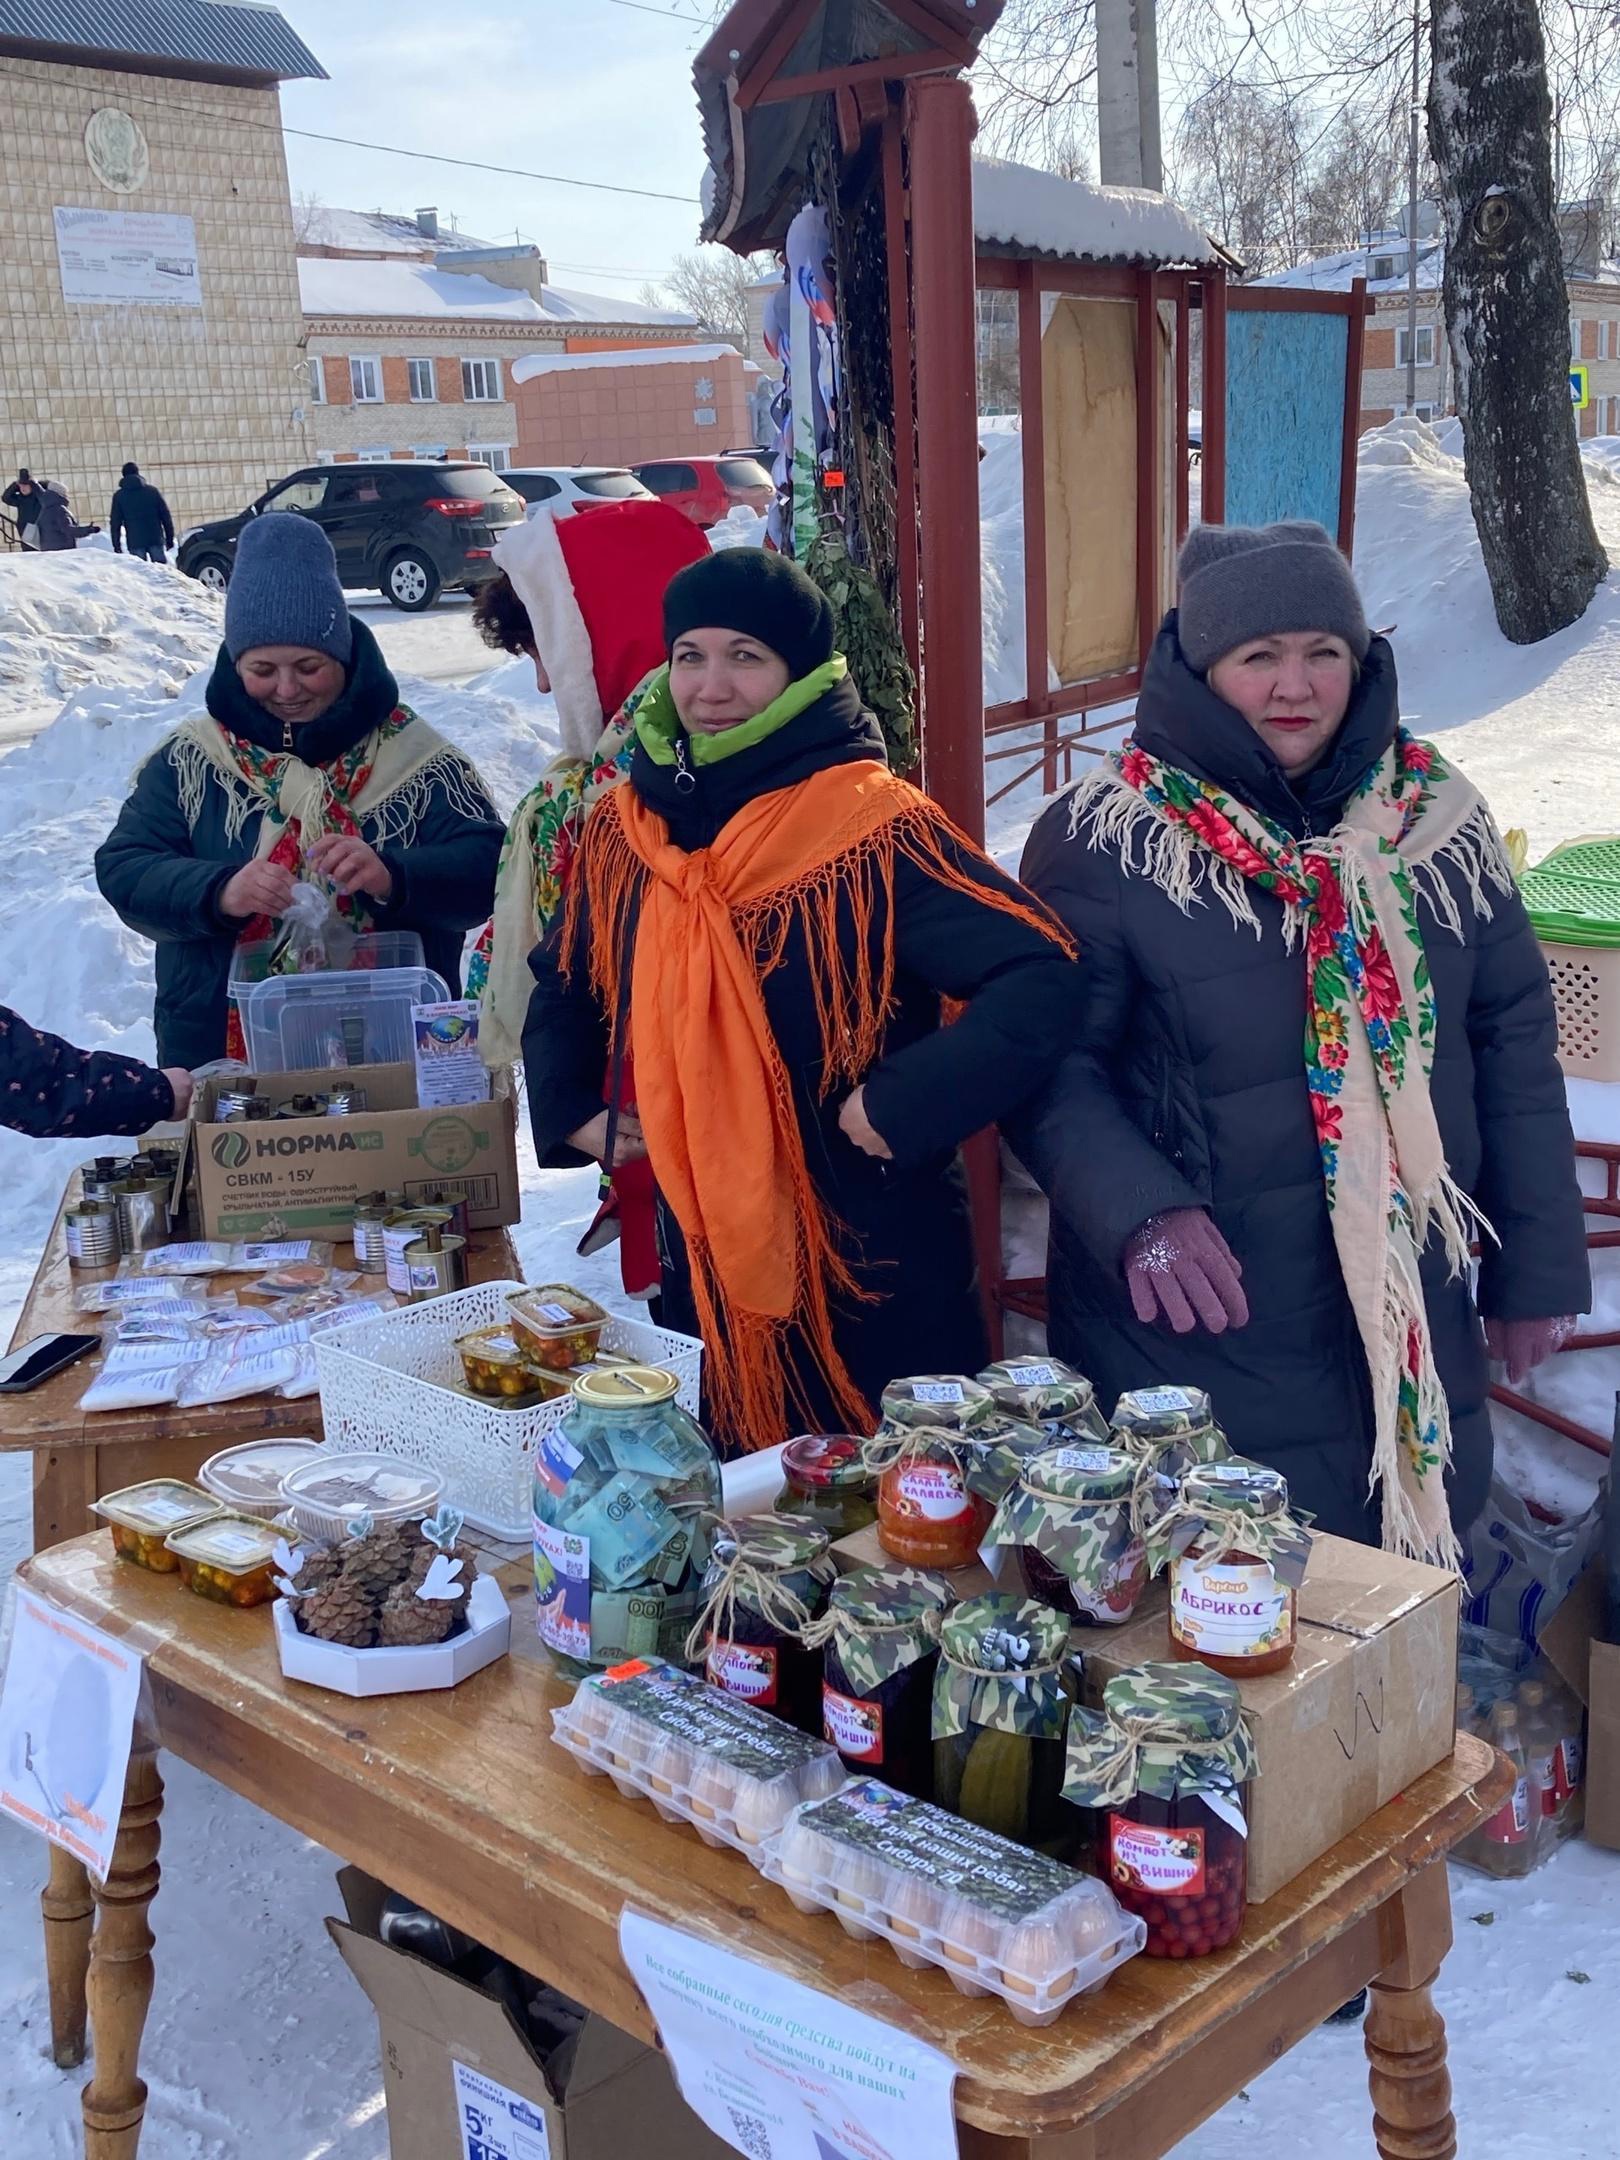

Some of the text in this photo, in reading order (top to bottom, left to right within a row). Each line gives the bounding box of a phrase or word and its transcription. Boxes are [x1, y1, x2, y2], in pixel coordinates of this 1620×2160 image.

[256, 1132, 356, 1157] НОРМА
[226, 1172, 273, 1187] СВКМ
[288, 1169, 315, 1182] 15У
[607, 1492, 636, 1521] 50
[628, 1599, 665, 1620] 100
[1181, 1587, 1264, 1616] АБРИКОС
[672, 1694, 697, 1713] для
[697, 1709, 737, 1736] наших
[693, 1688, 768, 1730] Домашнее
[659, 1711, 706, 1742] Сибирь
[881, 1825, 918, 1845] для
[918, 1839, 970, 1869] наших
[908, 1816, 1003, 1860] Домашнее
[1117, 1837, 1168, 1857] КОМПОТ
[876, 1840, 965, 1885] Сибирь 70
[1122, 1850, 1138, 1863] ИЗ
[1141, 1863, 1196, 1879] ВИШНИ
[645, 1953, 916, 2082] Все собранные сегодня средства пойдут на
[738, 2022, 826, 2070] необходимого
[828, 2062, 854, 2082] для
[857, 2073, 907, 2101] наших
[465, 2104, 484, 2137] 5
